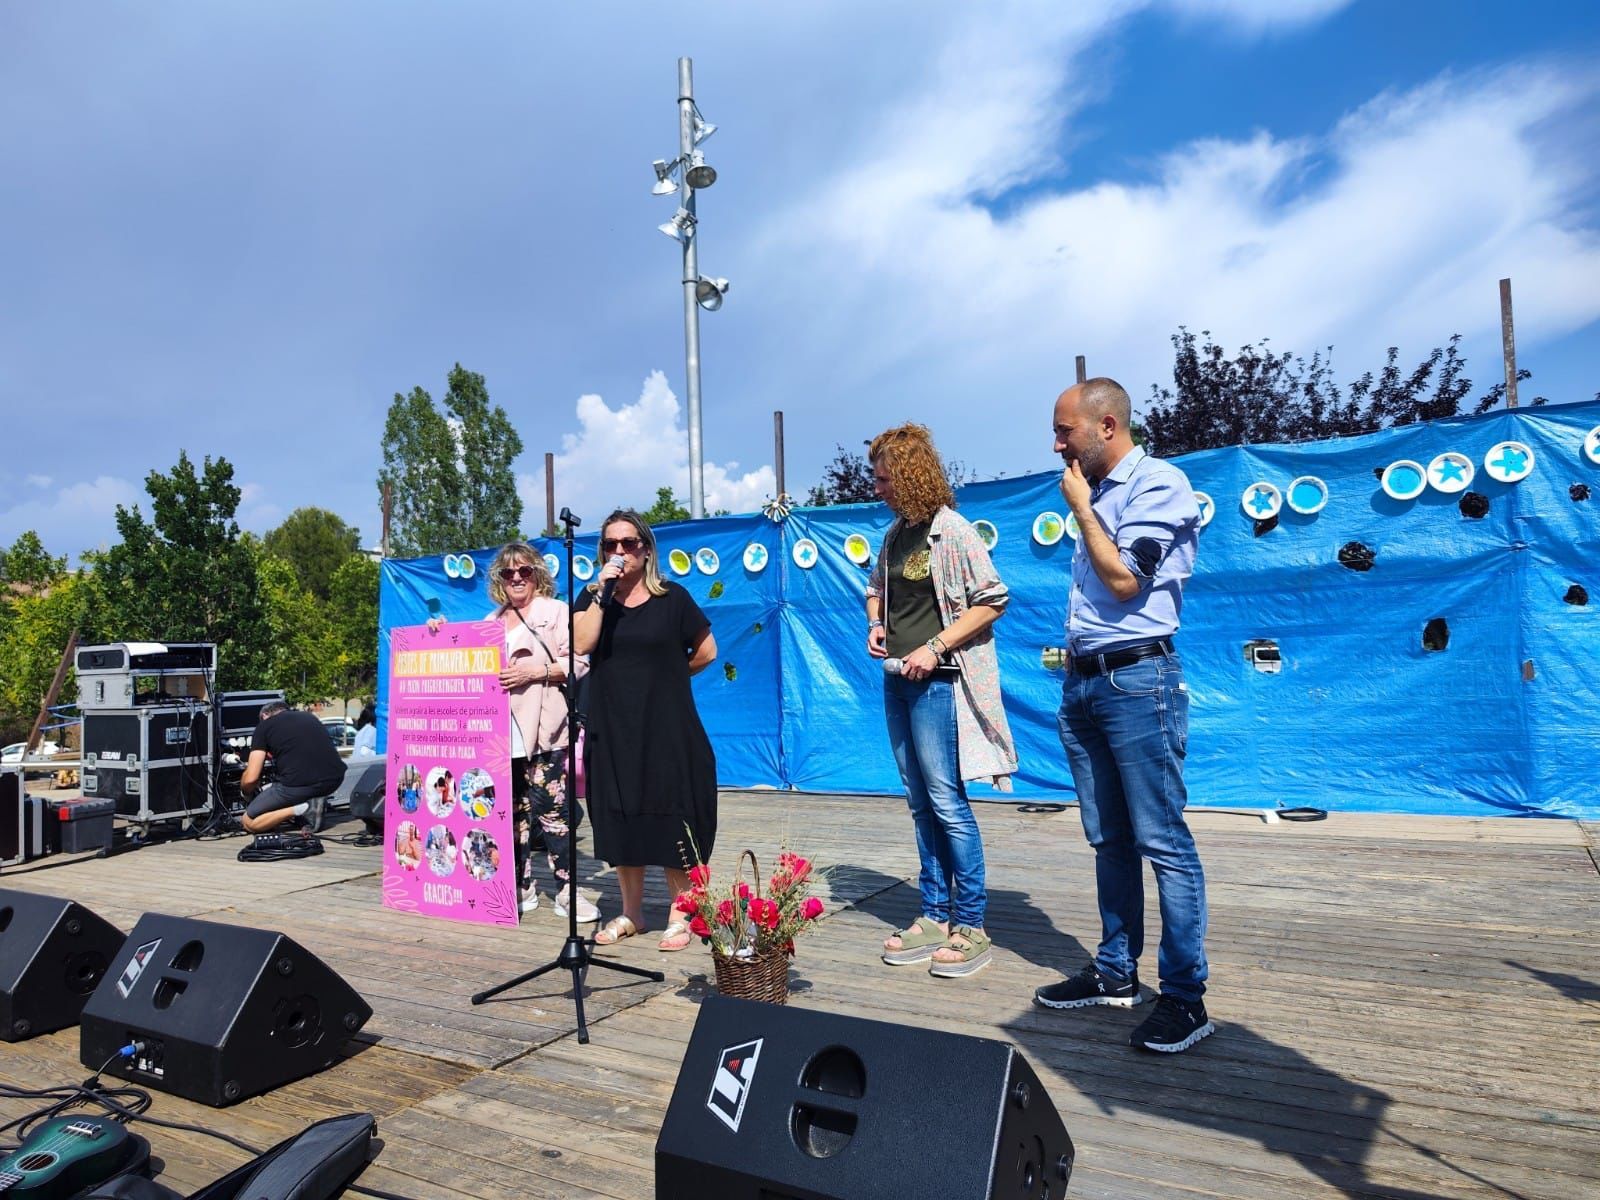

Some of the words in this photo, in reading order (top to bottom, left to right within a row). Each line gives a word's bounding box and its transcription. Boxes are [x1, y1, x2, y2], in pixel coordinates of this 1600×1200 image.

[430, 651, 470, 673] PRIMAVERA
[471, 650, 495, 672] 2023
[467, 677, 484, 692] POAL
[428, 706, 436, 714] les
[436, 706, 459, 715] escoles
[459, 706, 467, 715] de
[468, 706, 498, 717] primària
[467, 719, 493, 732] AMPANS
[468, 734, 484, 743] amb
